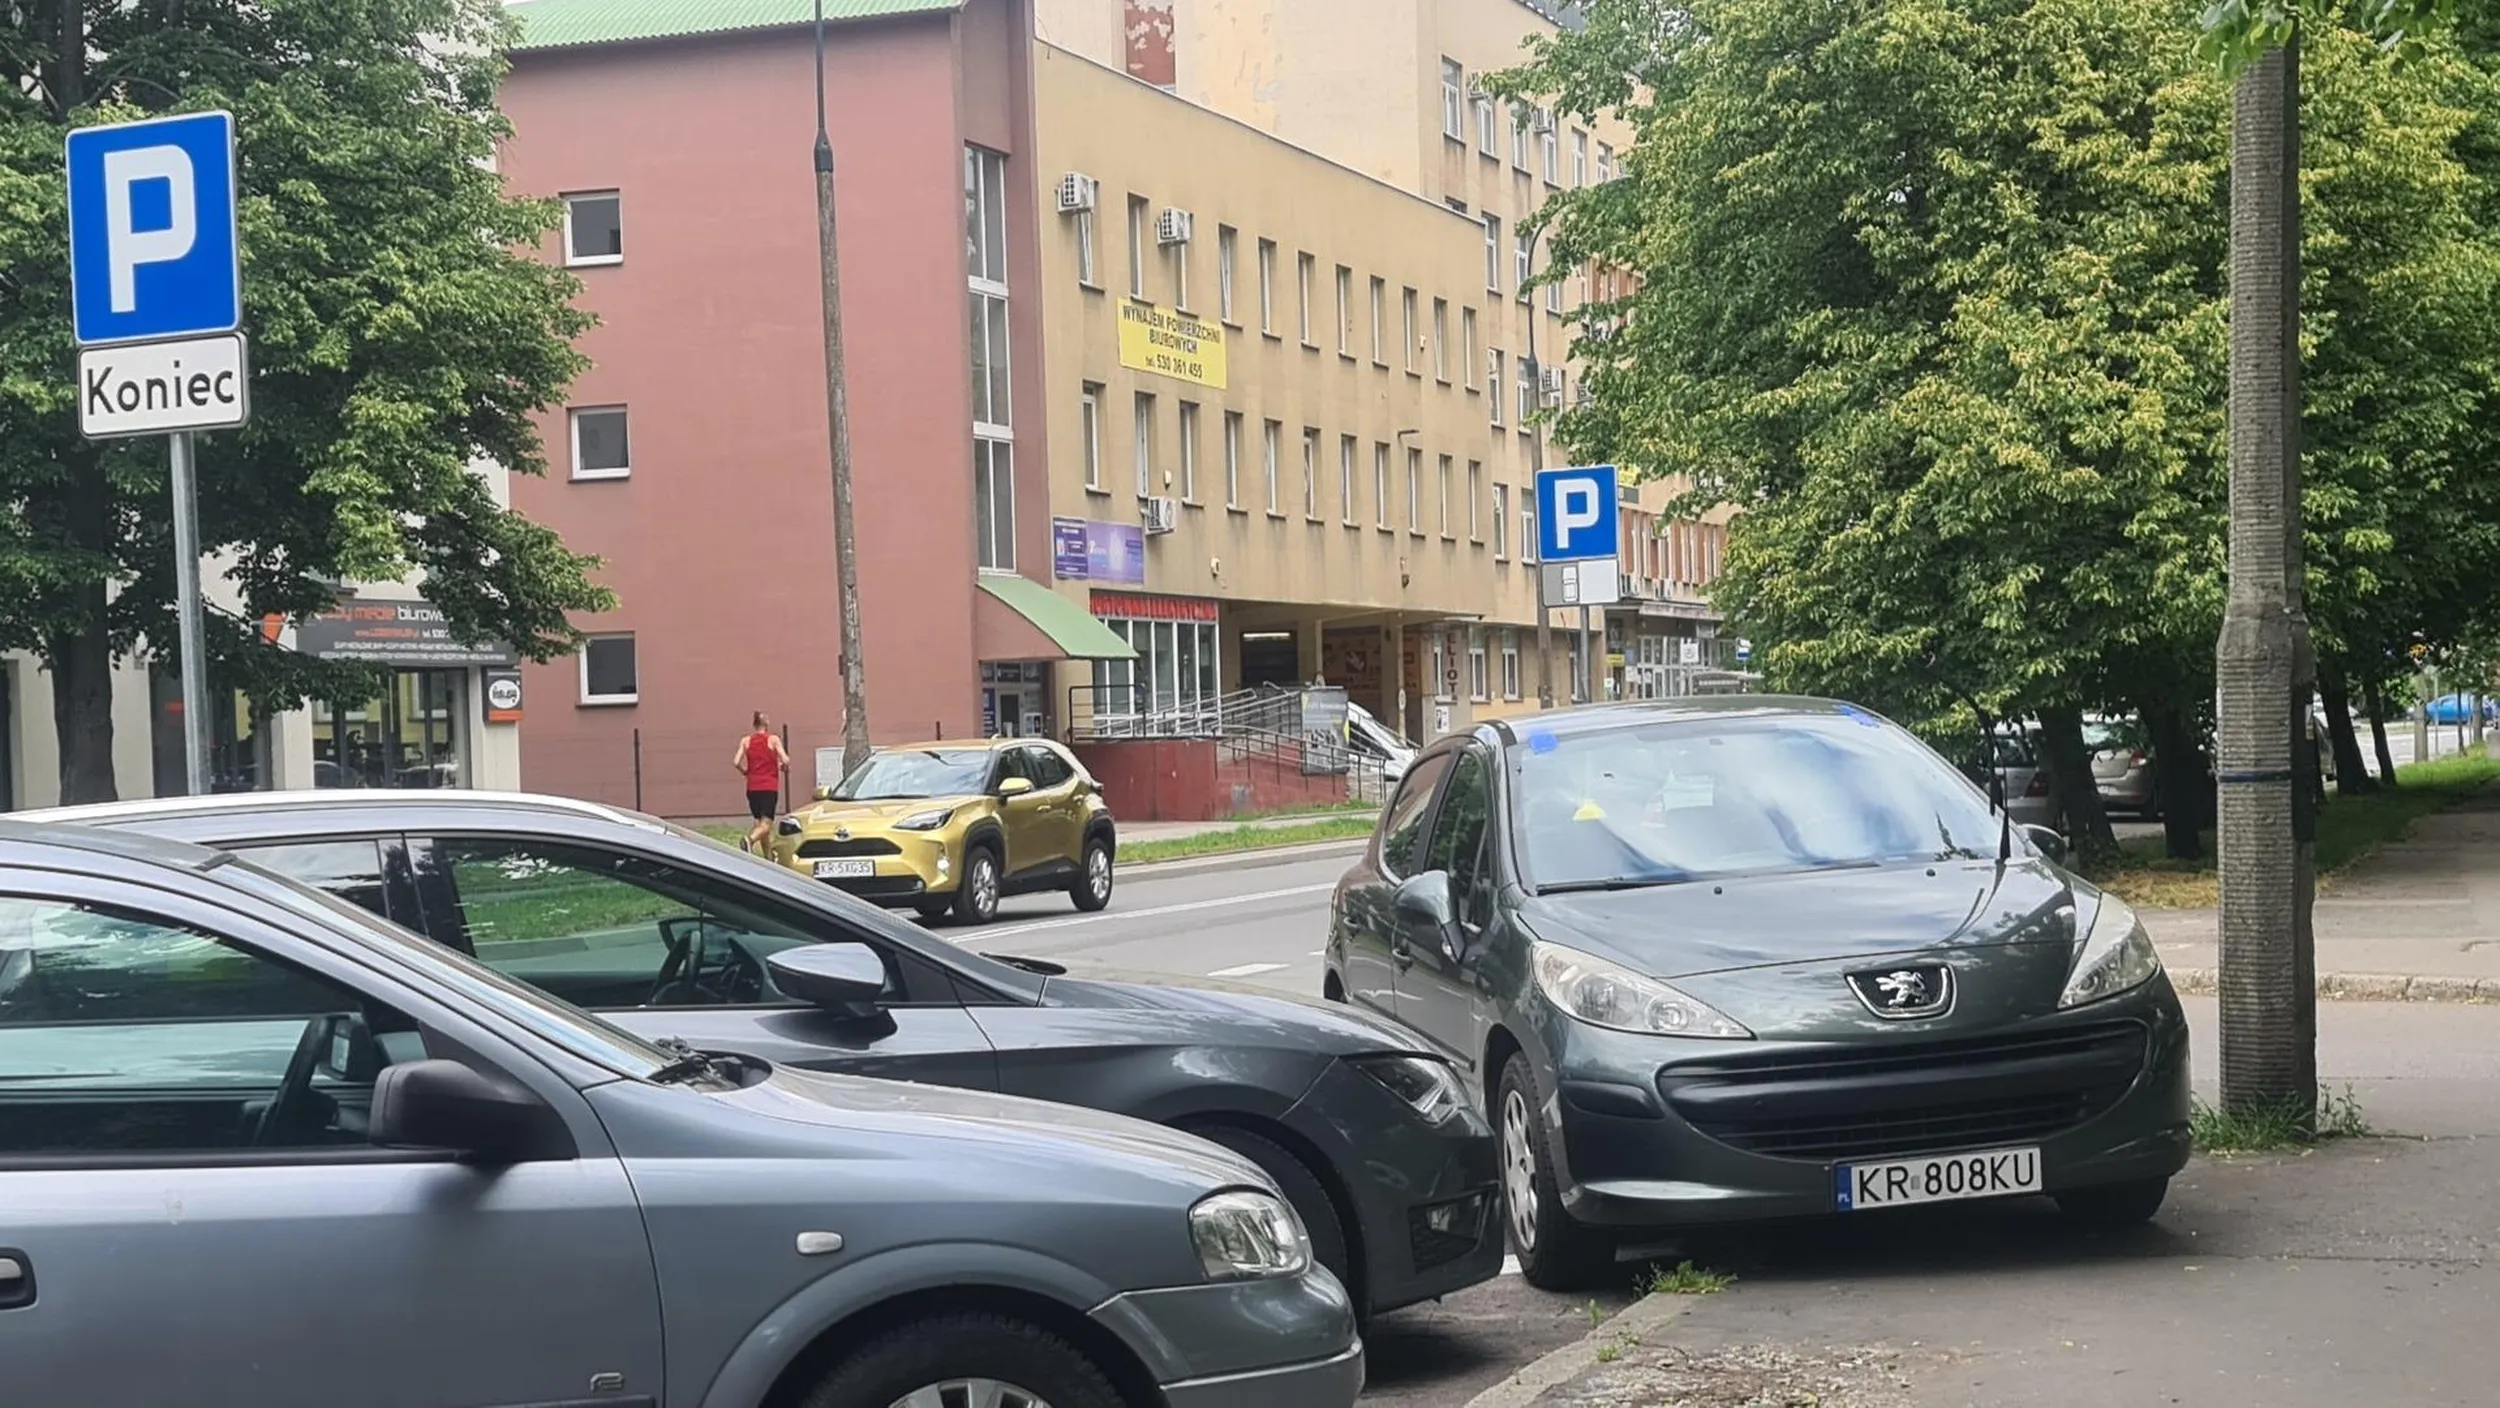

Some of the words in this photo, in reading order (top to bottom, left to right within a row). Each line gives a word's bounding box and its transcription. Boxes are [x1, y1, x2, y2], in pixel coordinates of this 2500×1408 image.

[104, 144, 196, 313] P
[1123, 305, 1165, 329] WYNAJEM
[1166, 316, 1221, 344] POWIERZCHNI
[1149, 328, 1198, 354] BIUROWYCH
[87, 360, 235, 416] Koniec
[1156, 353, 1171, 371] 530
[1173, 357, 1186, 375] 361
[1189, 362, 1203, 378] 455
[1554, 478, 1599, 549] P
[1858, 1165, 1909, 1204] KR
[1924, 1152, 2035, 1196] 808KU
